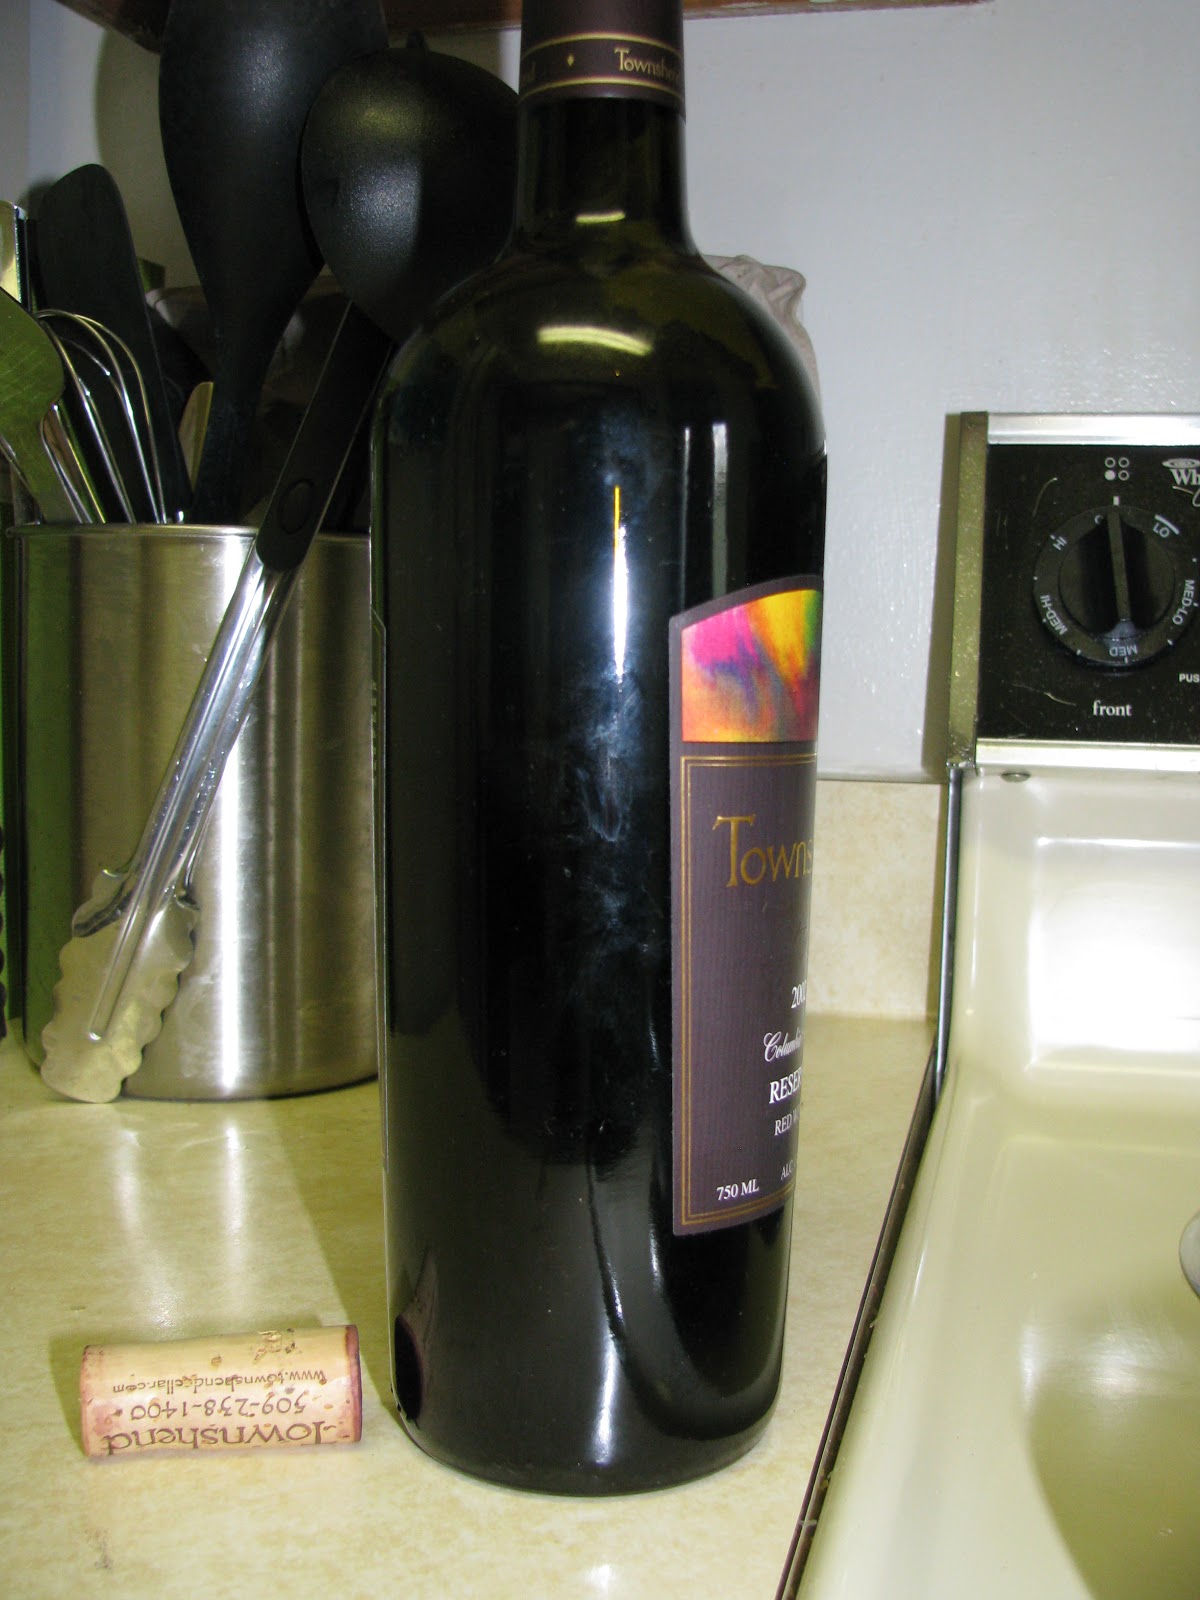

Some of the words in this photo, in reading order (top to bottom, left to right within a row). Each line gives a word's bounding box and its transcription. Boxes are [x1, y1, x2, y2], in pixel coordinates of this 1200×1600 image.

[1153, 522, 1170, 539] LO
[1053, 536, 1068, 551] HI
[1172, 579, 1195, 625] MED-LO
[1040, 594, 1068, 636] MED-HI
[1109, 644, 1138, 658] MED
[1092, 701, 1132, 717] front
[774, 1113, 792, 1136] RED
[716, 1183, 739, 1201] 750
[741, 1179, 760, 1193] ML
[112, 1369, 326, 1395] www.townshendcellar.com
[130, 1391, 308, 1420] 509-238-1400
[102, 1420, 337, 1456] Townshend
